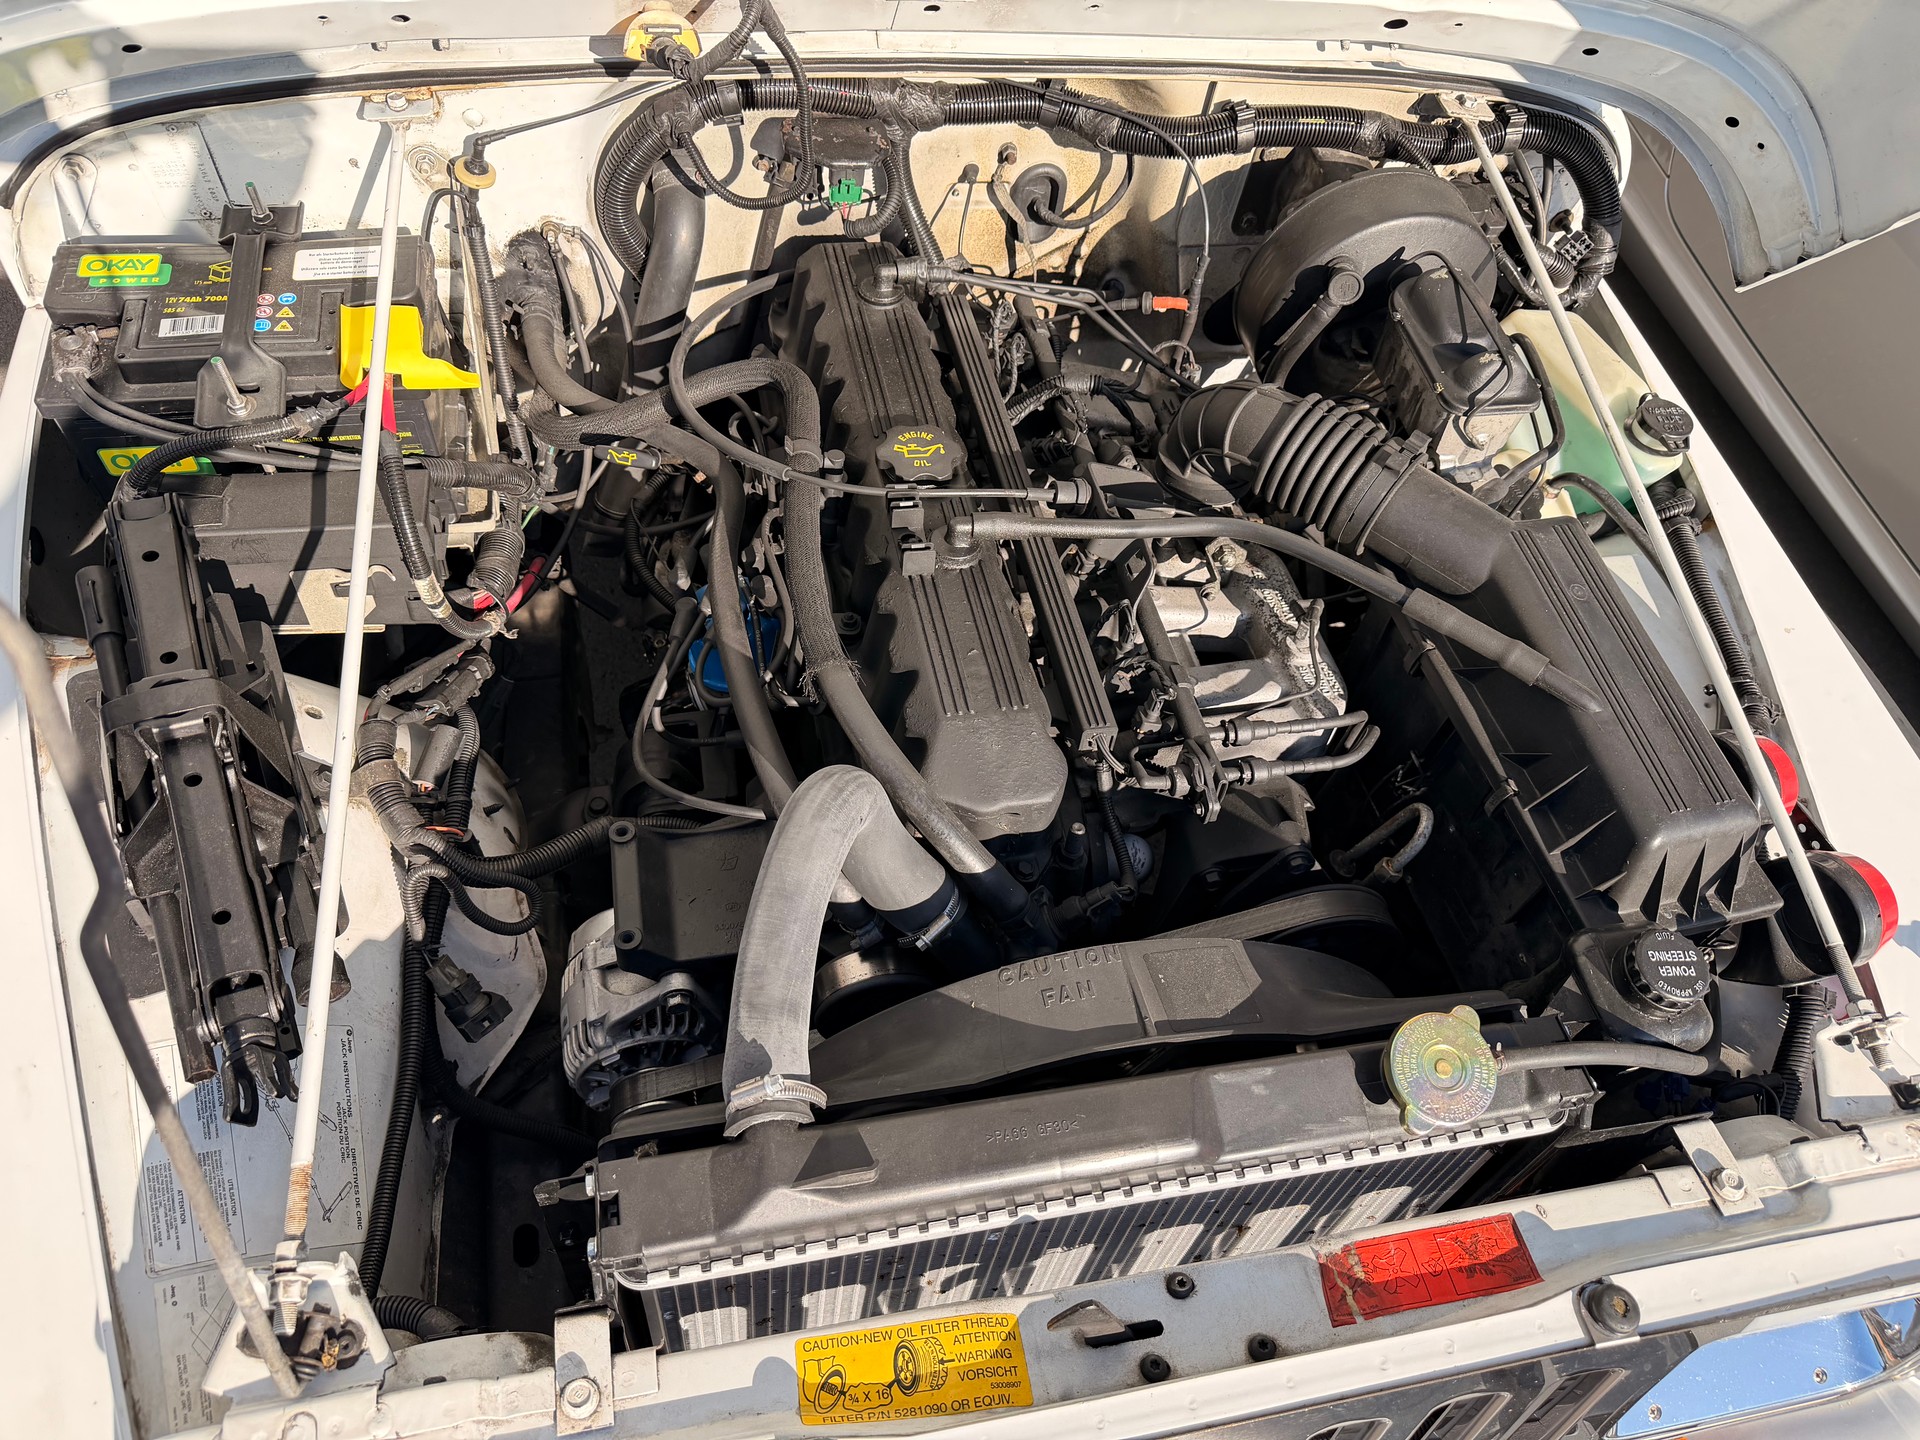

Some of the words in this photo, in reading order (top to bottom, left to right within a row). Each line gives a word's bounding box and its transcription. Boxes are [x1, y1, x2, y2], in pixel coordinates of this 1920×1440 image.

[86, 258, 154, 272] OKAY
[898, 431, 935, 442] ENGINE
[1655, 932, 1675, 941] FLUID
[1648, 950, 1698, 962] STEERING
[998, 943, 1123, 986] CAUTION
[1658, 965, 1696, 977] POWER
[1040, 979, 1096, 1008] FAN
[1657, 981, 1693, 997] APPROVED
[1695, 980, 1706, 994] USE
[341, 1060, 353, 1117] INSTRUCTIONS
[334, 1101, 343, 1134] POSITION
[338, 1135, 344, 1145] DU
[343, 1125, 351, 1158] POSITION
[348, 1147, 360, 1195] DIRECTIVES
[354, 1197, 360, 1208] DE
[227, 1178, 236, 1216] UTILISATION
[176, 1189, 186, 1224] ATTENTION
[803, 1330, 892, 1353] CAUTION-NEW
[898, 1327, 917, 1339] OIL
[920, 1322, 960, 1337] FILTER
[962, 1317, 1009, 1331] THREAD
[953, 1331, 1017, 1346] ATTENTION
[955, 1348, 1012, 1364] WARNING
[957, 1365, 1018, 1382] VORSICHT
[990, 1381, 1022, 1389] 53008907
[863, 1391, 871, 1401] X
[876, 1388, 889, 1401] 16
[822, 1412, 865, 1424] FILTER
[867, 1409, 891, 1422] P/N
[894, 1402, 948, 1418] 5281090
[950, 1399, 969, 1411] OR
[974, 1394, 1014, 1407] EQUIV.
